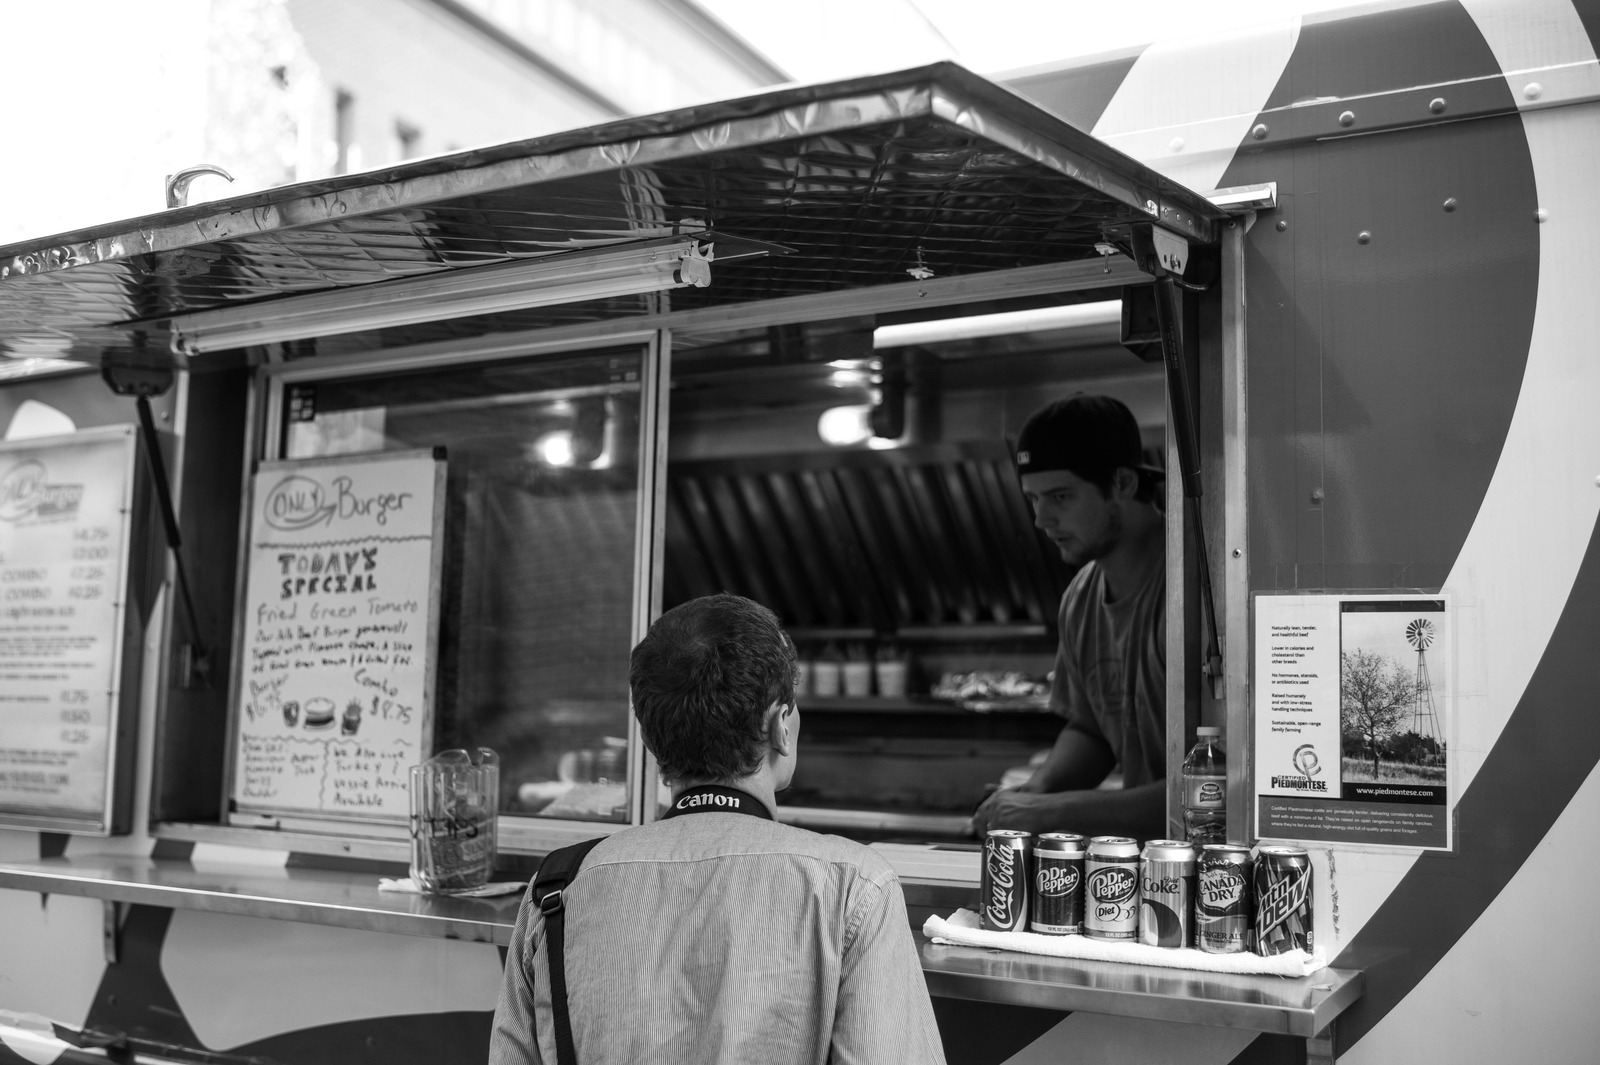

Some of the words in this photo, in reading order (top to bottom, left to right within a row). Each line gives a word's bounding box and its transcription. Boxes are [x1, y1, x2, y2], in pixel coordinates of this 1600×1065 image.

[332, 475, 413, 526] Burger
[280, 574, 377, 600] SPECIAL
[257, 602, 297, 626] Fried
[310, 602, 357, 620] Green
[365, 596, 418, 615] Tomato
[354, 668, 398, 697] Combo
[1271, 776, 1327, 790] PIEDMONTESE
[1356, 787, 1434, 797] www.piedmontese.com
[676, 792, 740, 810] Canon
[1037, 868, 1077, 893] Pepper
[1048, 865, 1068, 879] Dr
[1106, 871, 1125, 886] Dr
[1163, 876, 1180, 884] Diet
[1092, 874, 1135, 898] Pepper
[1143, 877, 1178, 894] Coke
[1198, 873, 1247, 896] CANADA
[1209, 888, 1235, 903] DRY
[1098, 906, 1116, 917] Diet
[1199, 930, 1228, 940] GINGER
[1228, 932, 1245, 941] ALE
